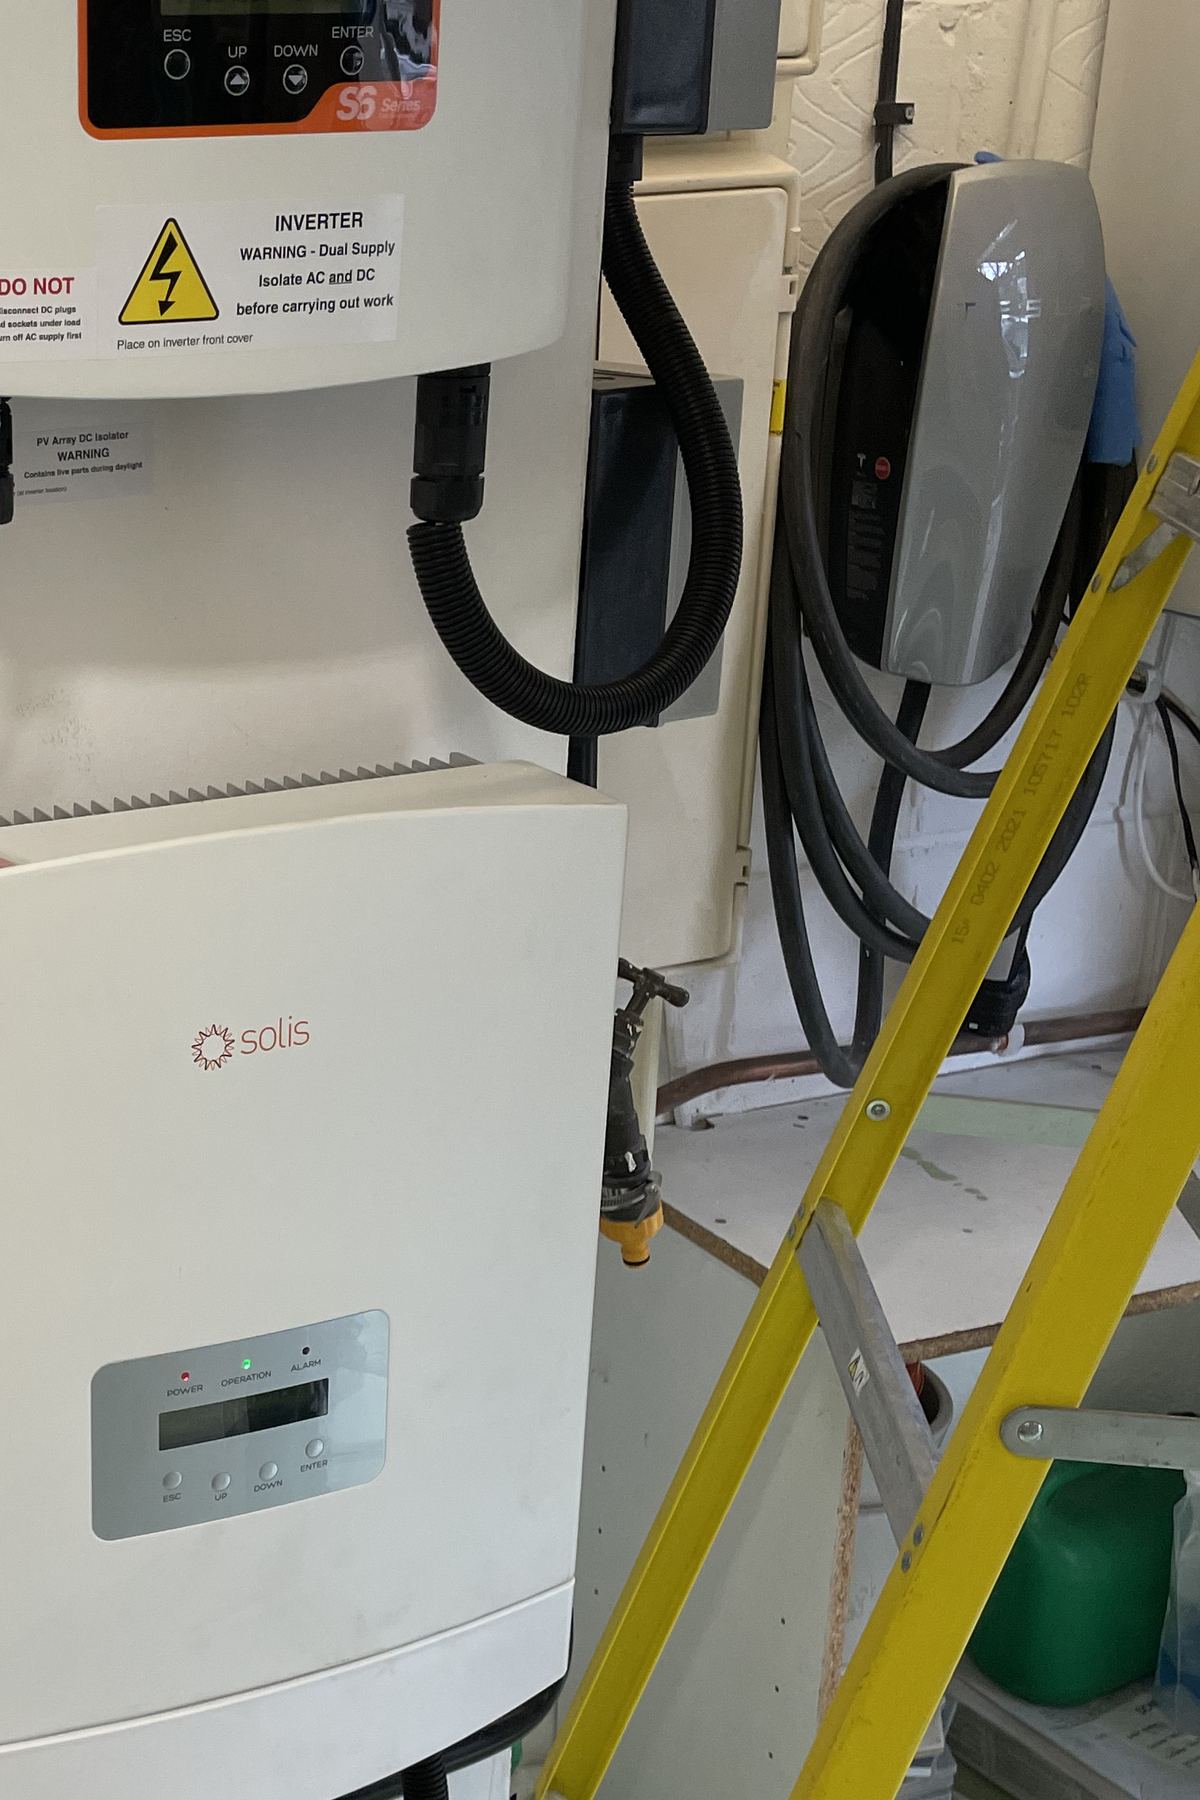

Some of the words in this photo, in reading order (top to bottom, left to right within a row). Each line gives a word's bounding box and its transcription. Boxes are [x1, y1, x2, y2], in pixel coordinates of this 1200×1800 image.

[163, 29, 192, 42] ESC
[332, 26, 374, 39] ENTER
[228, 46, 247, 58] UP
[274, 44, 318, 57] DOWN
[336, 86, 377, 121] S6
[381, 97, 421, 112] Series
[275, 212, 363, 232] INVERTER
[240, 245, 306, 261] WARNING
[319, 243, 348, 257] Dual
[352, 240, 395, 257] Supply
[259, 273, 302, 287] Isolate
[306, 271, 325, 284] AC
[329, 270, 352, 285] and
[357, 268, 375, 281] DC
[33, 277, 75, 295] NOT
[41, 306, 53, 314] DC
[54, 306, 77, 315] plugs
[237, 302, 278, 316] before
[283, 299, 336, 314] carrying
[339, 296, 360, 310] out
[364, 294, 394, 307] work
[8, 320, 38, 328] sockets
[40, 319, 62, 327] under
[25, 333, 37, 341] AC
[39, 333, 64, 341] supply
[117, 339, 145, 350] Place
[148, 340, 160, 349] on
[163, 337, 200, 347] inverter
[202, 334, 224, 345] front
[227, 333, 254, 344] cover
[37, 437, 49, 447] PV
[52, 435, 77, 446] Array
[79, 433, 93, 443] DC
[95, 431, 129, 442] Isolator
[57, 447, 110, 462] WARNING
[24, 469, 55, 479] Contains
[57, 468, 69, 476] live
[71, 467, 89, 476] parts
[91, 465, 114, 474] during
[115, 461, 143, 471] daylight
[240, 1015, 310, 1055] solis
[290, 1359, 322, 1372] ALARM
[221, 1371, 272, 1388] OPERATION
[167, 1384, 204, 1397] POWER
[300, 1460, 328, 1473] ENTER
[253, 1480, 283, 1493] DOWN
[162, 1492, 182, 1503] ESC
[214, 1492, 228, 1502] UP
